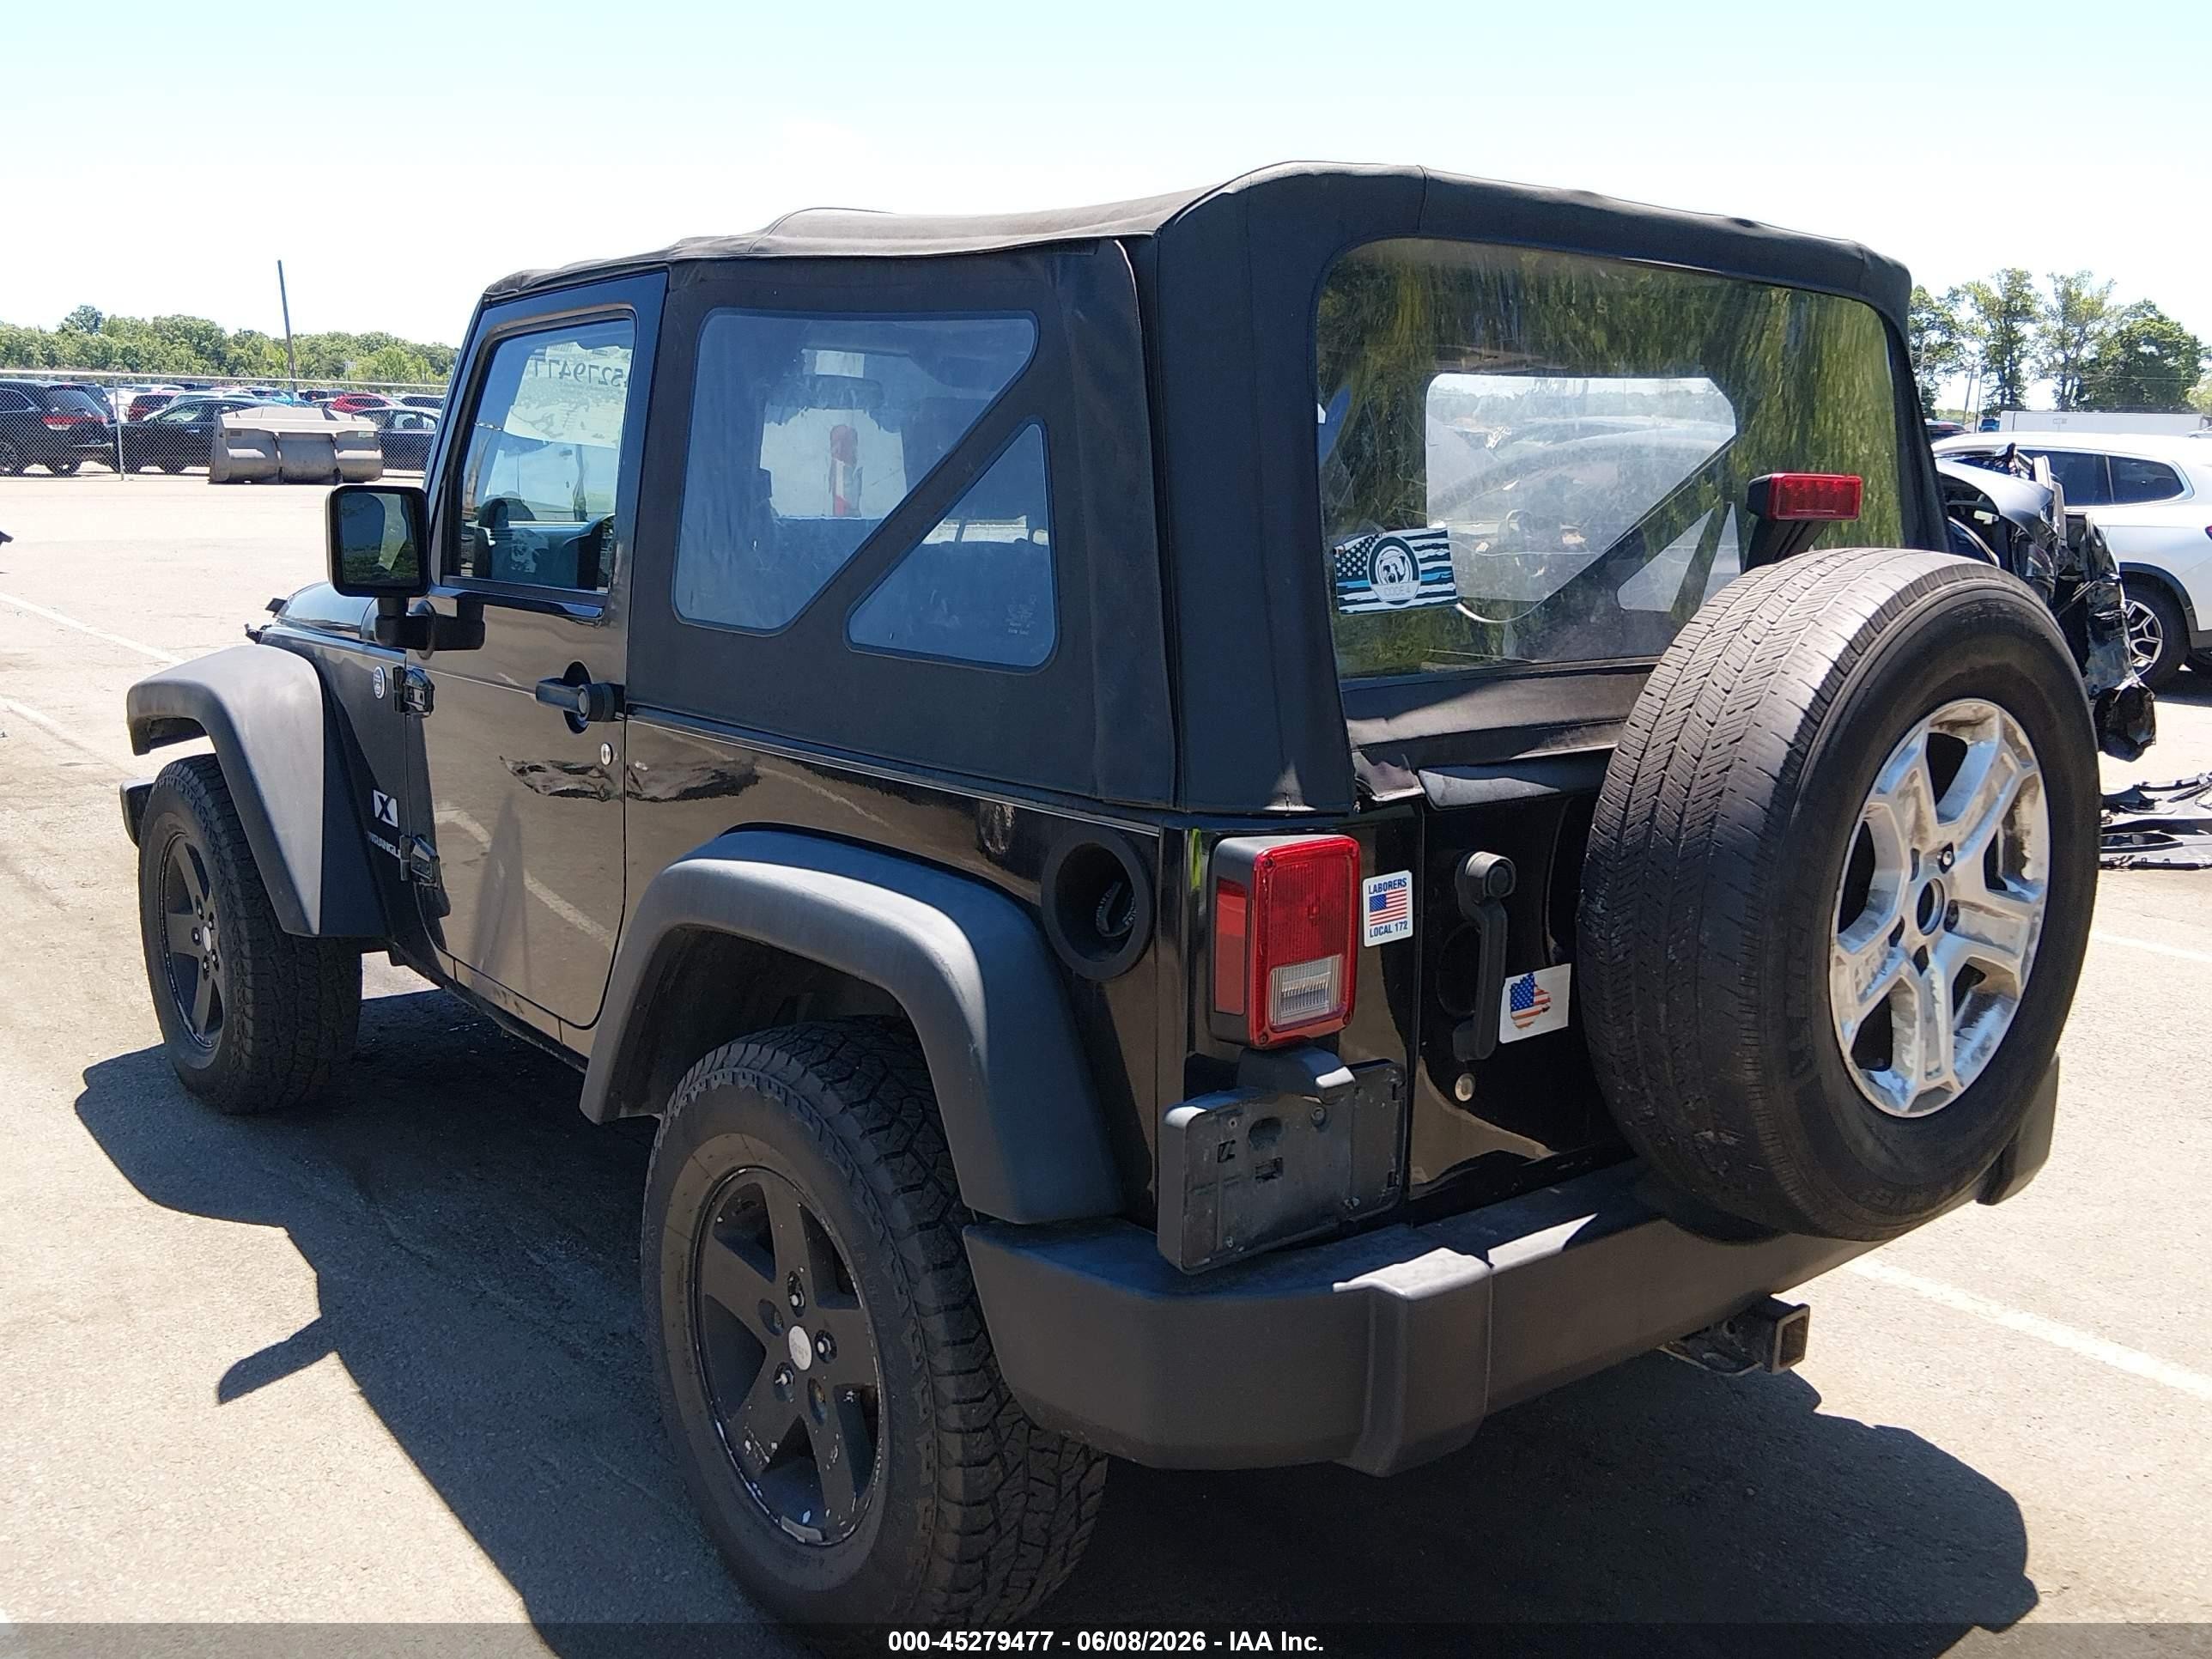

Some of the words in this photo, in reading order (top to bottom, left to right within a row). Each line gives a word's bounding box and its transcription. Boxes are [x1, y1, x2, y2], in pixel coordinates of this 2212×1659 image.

[1368, 878, 1407, 894] LABORERS
[1370, 924, 1393, 938] LOCAL
[1395, 921, 1408, 932] 172
